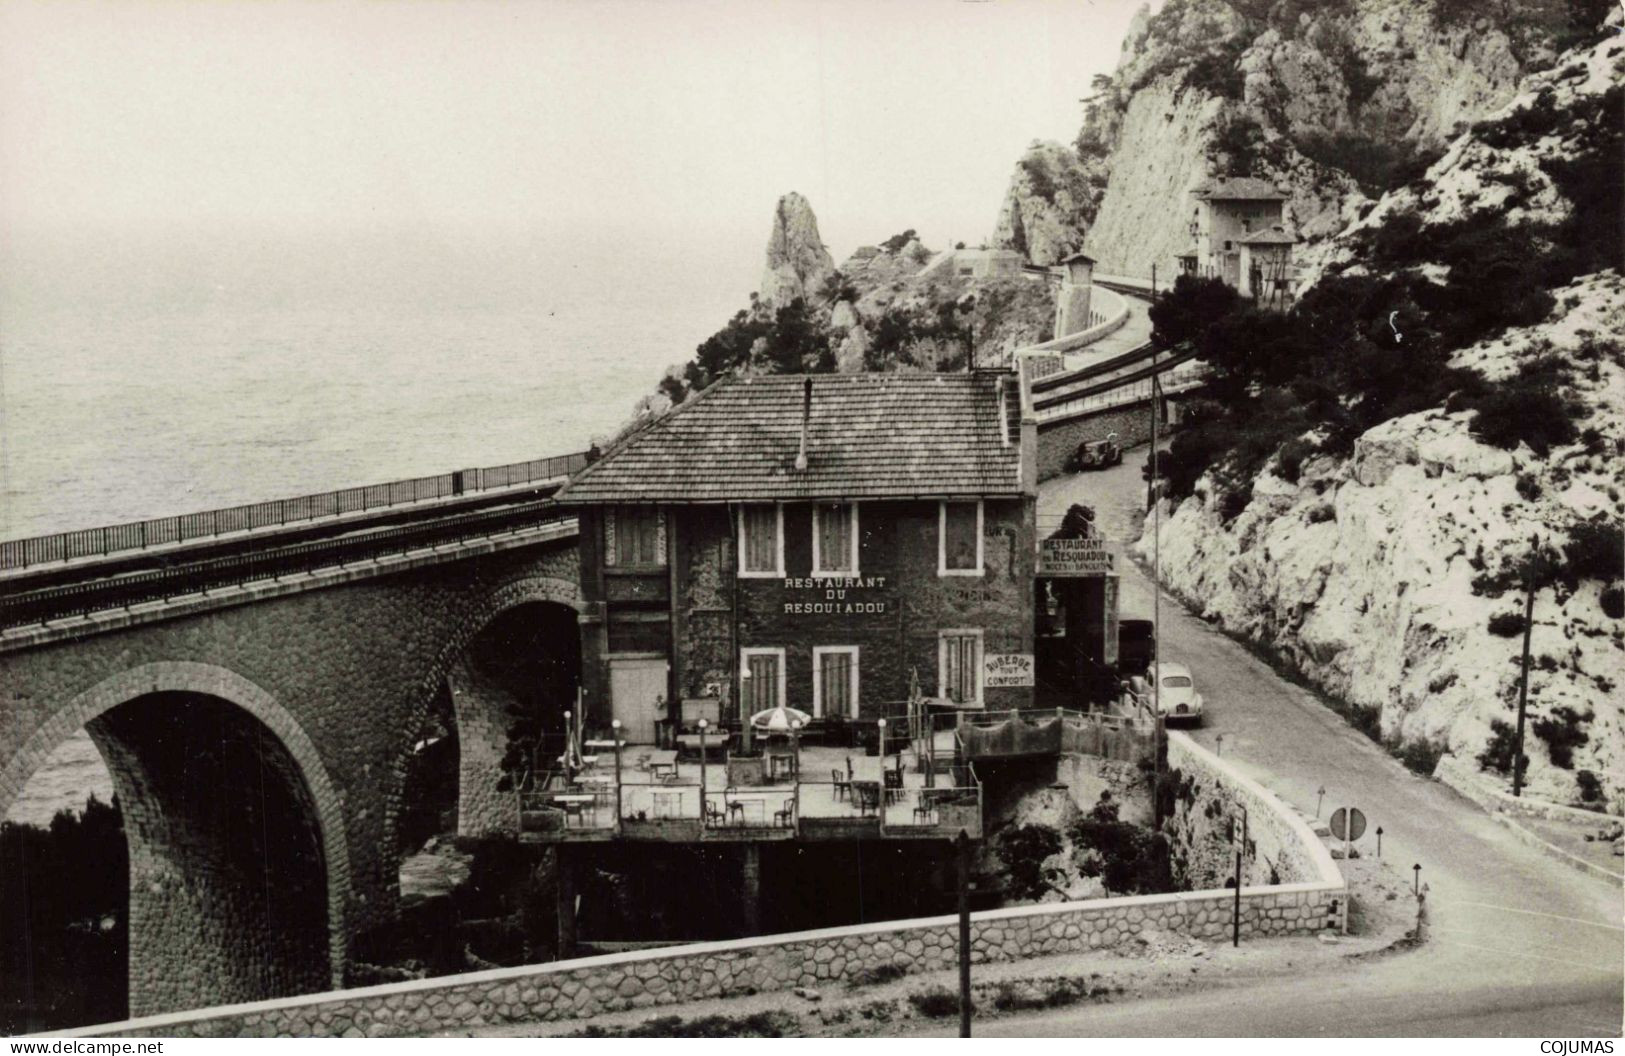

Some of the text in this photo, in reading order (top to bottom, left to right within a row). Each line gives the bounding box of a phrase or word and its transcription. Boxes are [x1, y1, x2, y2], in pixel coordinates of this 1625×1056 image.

[1043, 540, 1103, 550] RESTAURANT
[1053, 551, 1106, 563] RESQUIADOU
[784, 577, 886, 588] RESTAURANT
[825, 589, 846, 600] DU
[986, 655, 1031, 673] AUBERGE
[1000, 666, 1018, 674] TOUT
[987, 676, 1026, 686] CONFORT
